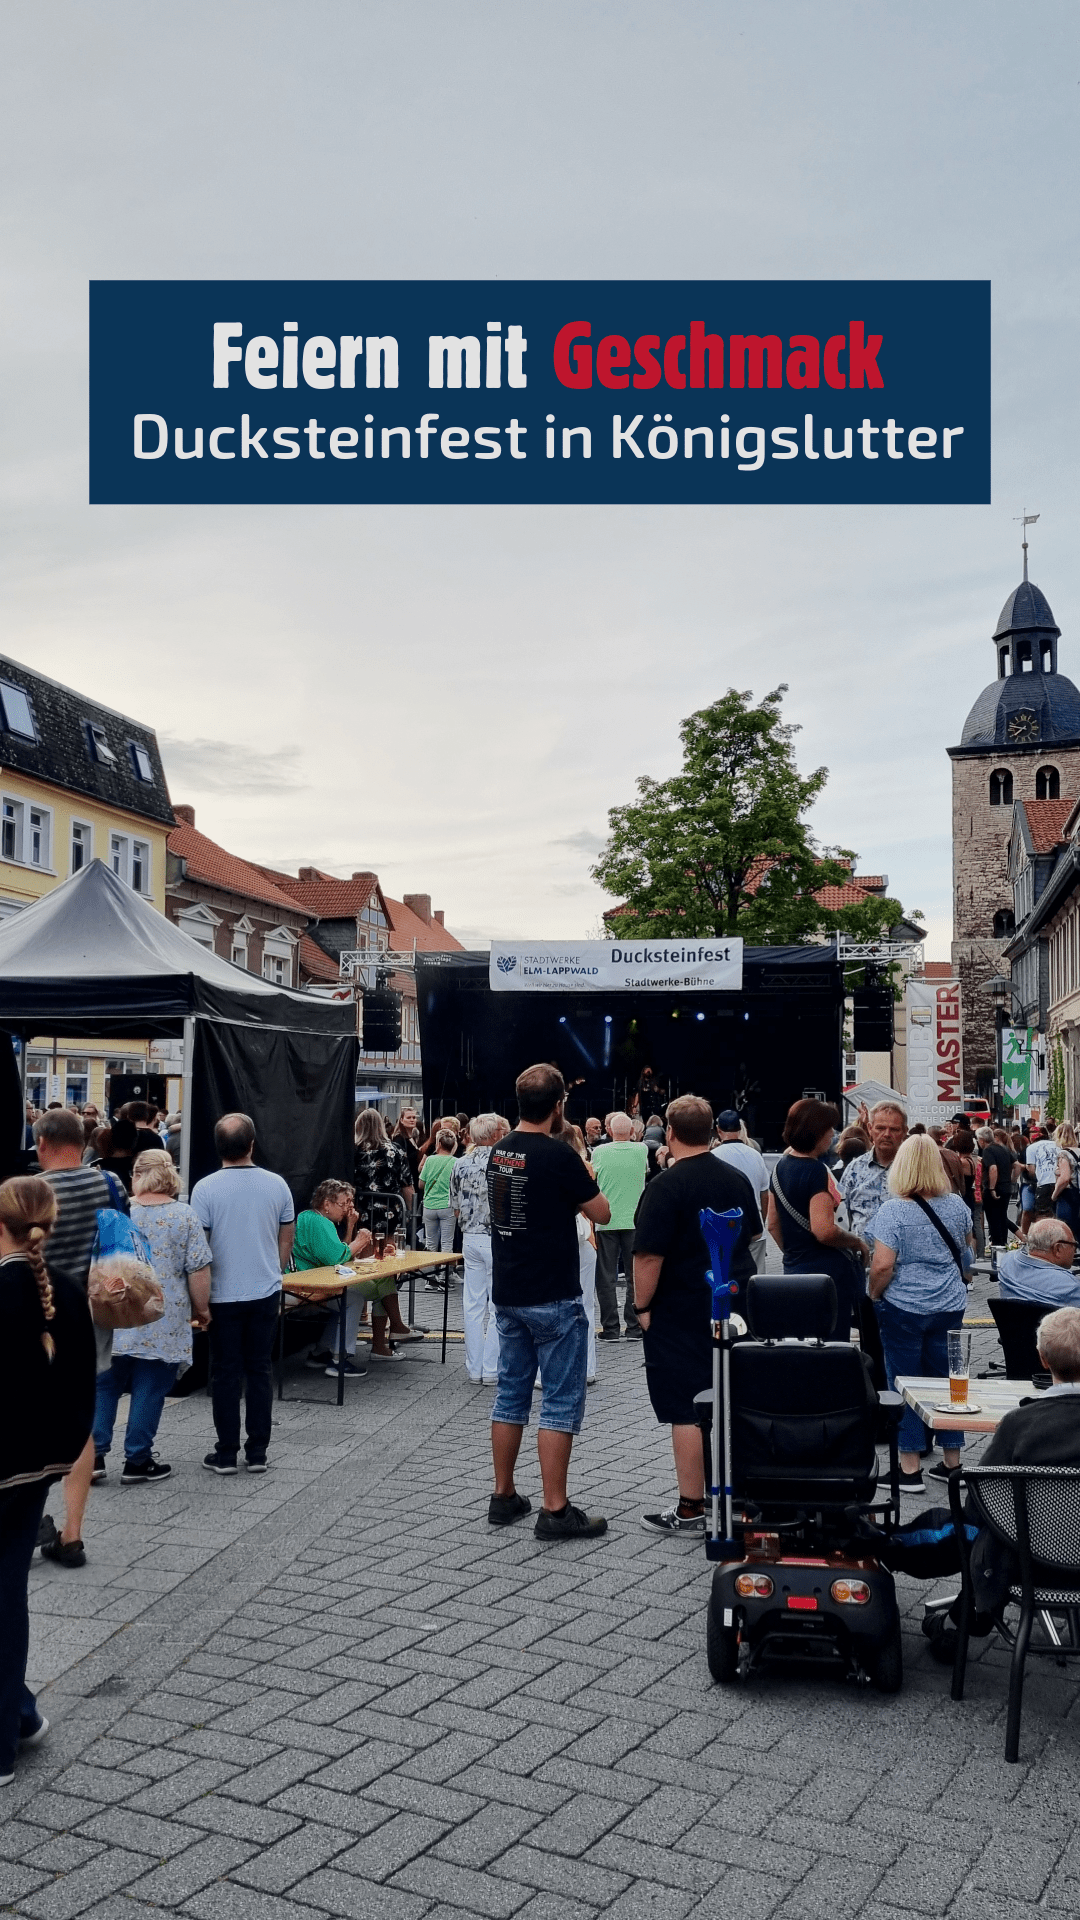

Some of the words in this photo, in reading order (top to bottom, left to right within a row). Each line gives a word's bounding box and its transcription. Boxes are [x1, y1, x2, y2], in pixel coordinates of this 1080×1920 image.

[611, 947, 731, 963] Ducksteinfest
[524, 956, 580, 964] STADTWERKE
[523, 967, 599, 975] ELM-LAPPWALD
[625, 977, 715, 987] Stadtwerke-Bühne
[936, 983, 961, 1101] MASTER
[909, 1026, 934, 1102] CLUB
[909, 1105, 962, 1114] WELCOME
[495, 1149, 506, 1157] WAR
[499, 1165, 514, 1174] TOUR
